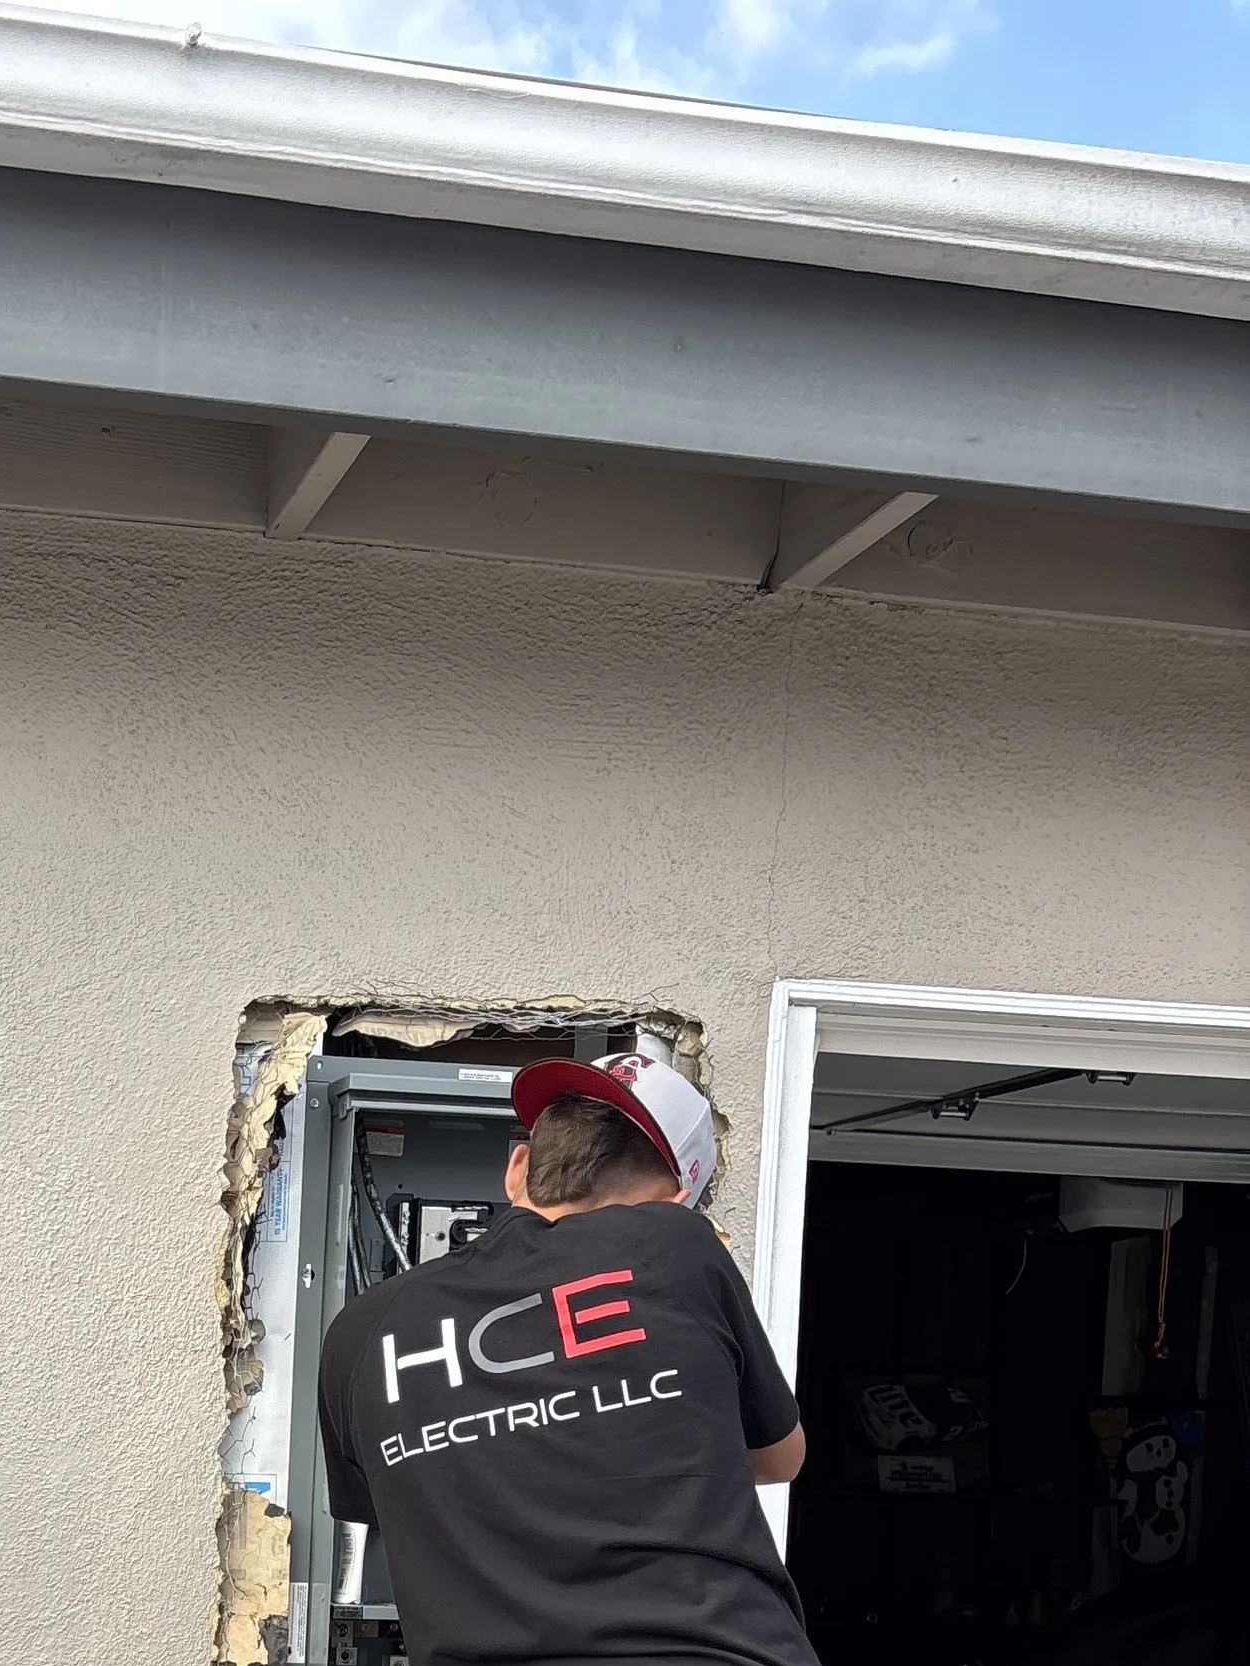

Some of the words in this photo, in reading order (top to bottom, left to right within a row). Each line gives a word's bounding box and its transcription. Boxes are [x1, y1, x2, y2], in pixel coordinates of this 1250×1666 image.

[382, 1269, 647, 1404] HCE
[380, 1391, 580, 1466] ELECTRIC
[592, 1369, 682, 1413] LLC
